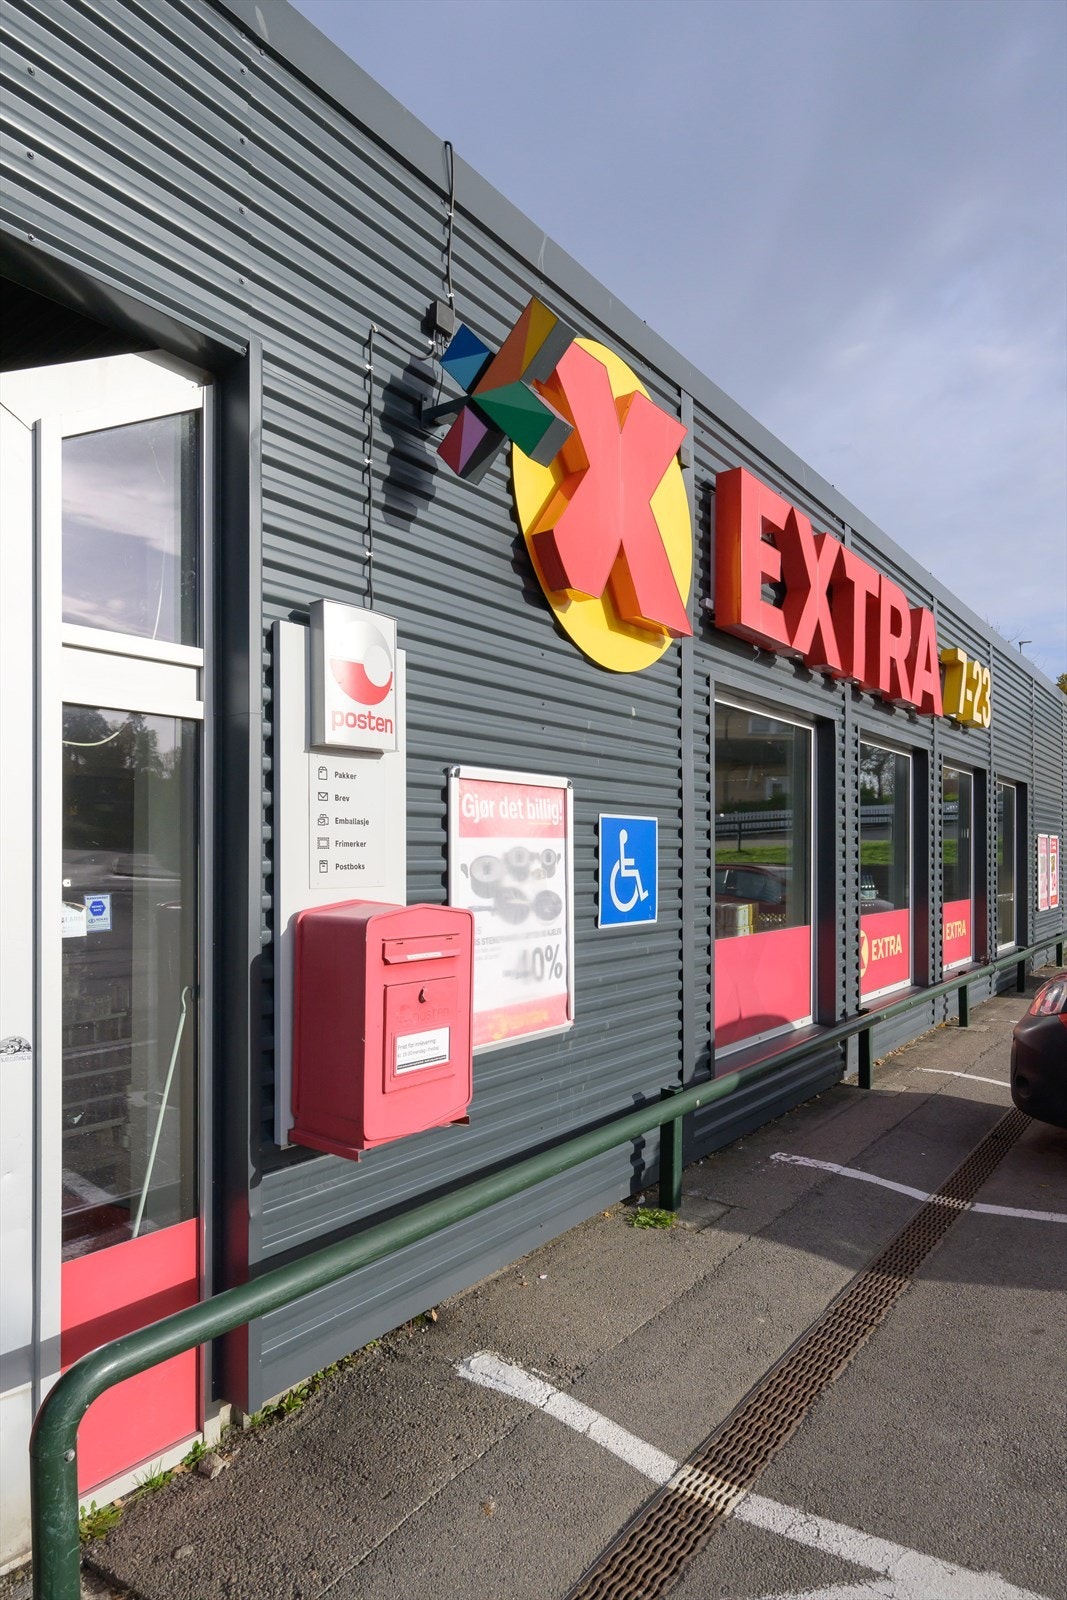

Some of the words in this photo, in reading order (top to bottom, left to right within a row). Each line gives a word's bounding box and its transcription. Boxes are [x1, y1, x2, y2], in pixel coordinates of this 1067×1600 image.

[720, 466, 943, 718] EXTRA
[951, 648, 991, 729] 7-23
[331, 710, 393, 734] posten
[334, 771, 358, 781] Pakker
[334, 794, 350, 802] Brev
[461, 793, 495, 824] Gjør
[499, 796, 525, 820] det
[526, 797, 563, 826] billig!
[334, 817, 370, 827] Emballasje
[335, 839, 367, 848] Frimerker
[335, 862, 366, 871] Postboks
[946, 920, 967, 940] EXTRA
[871, 933, 903, 961] EXTRA
